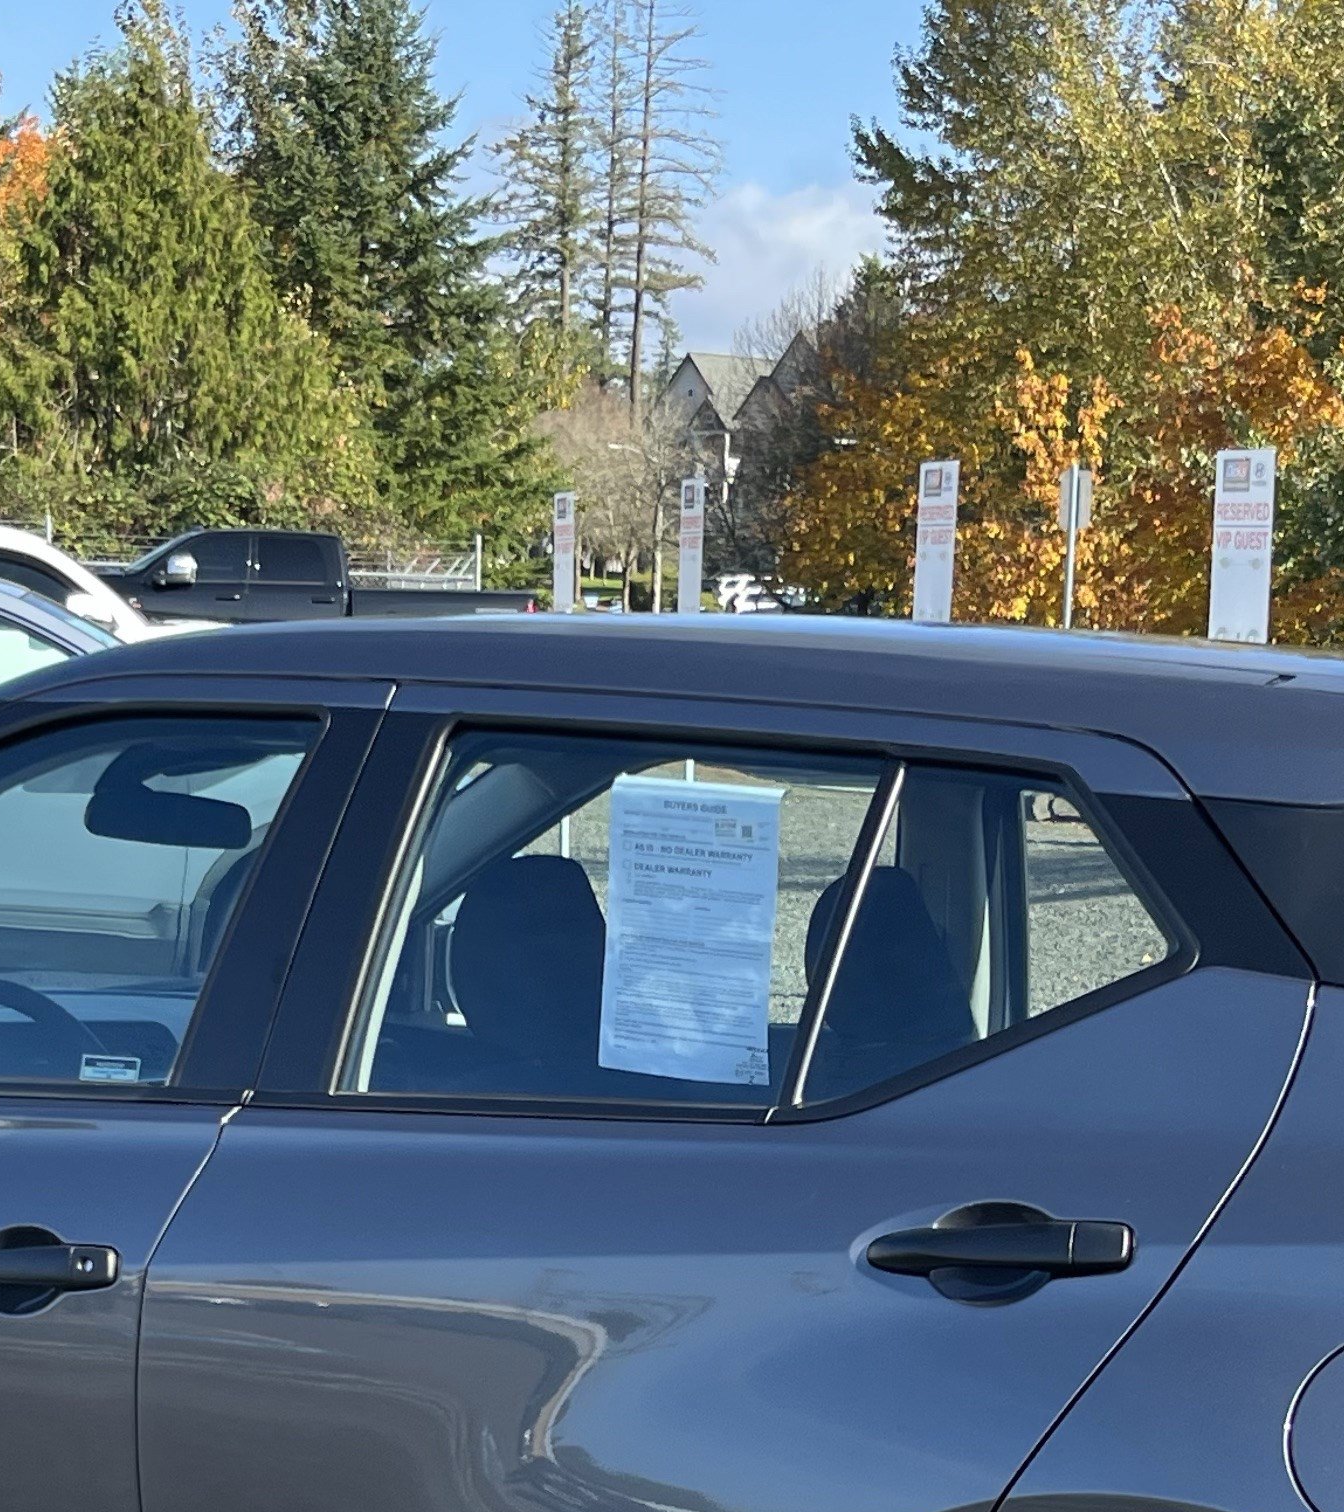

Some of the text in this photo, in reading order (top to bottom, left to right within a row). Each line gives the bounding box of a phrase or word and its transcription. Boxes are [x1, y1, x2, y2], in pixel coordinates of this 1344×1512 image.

[1216, 502, 1271, 521] RESERVED
[1216, 530, 1269, 550] VIP GUEST
[663, 800, 727, 815] BUYERS GUIDE
[635, 842, 645, 852] AS
[661, 845, 672, 854] NO
[674, 845, 706, 857] DEALER
[708, 849, 754, 862] WARRANTY
[634, 862, 713, 878] DEALER WARRANTY
